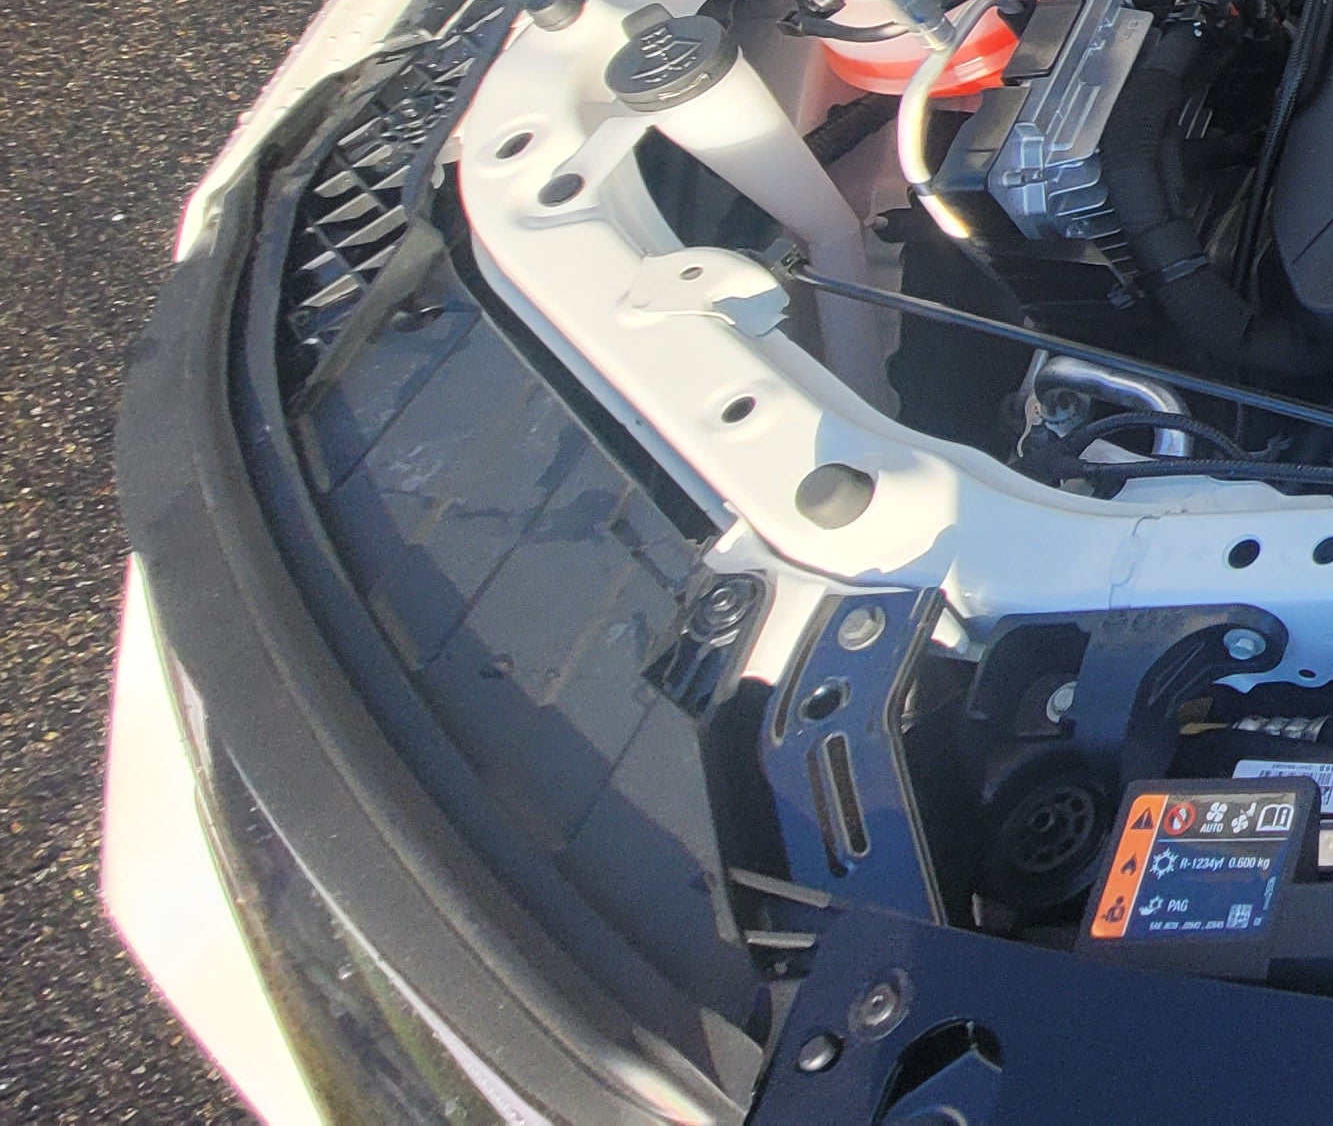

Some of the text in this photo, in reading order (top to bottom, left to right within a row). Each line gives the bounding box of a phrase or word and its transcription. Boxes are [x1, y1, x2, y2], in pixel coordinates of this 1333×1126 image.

[1200, 823, 1224, 833] AUTO
[1180, 857, 1270, 871] R-1234yf 0.600 kg
[1167, 899, 1189, 913] PAG
